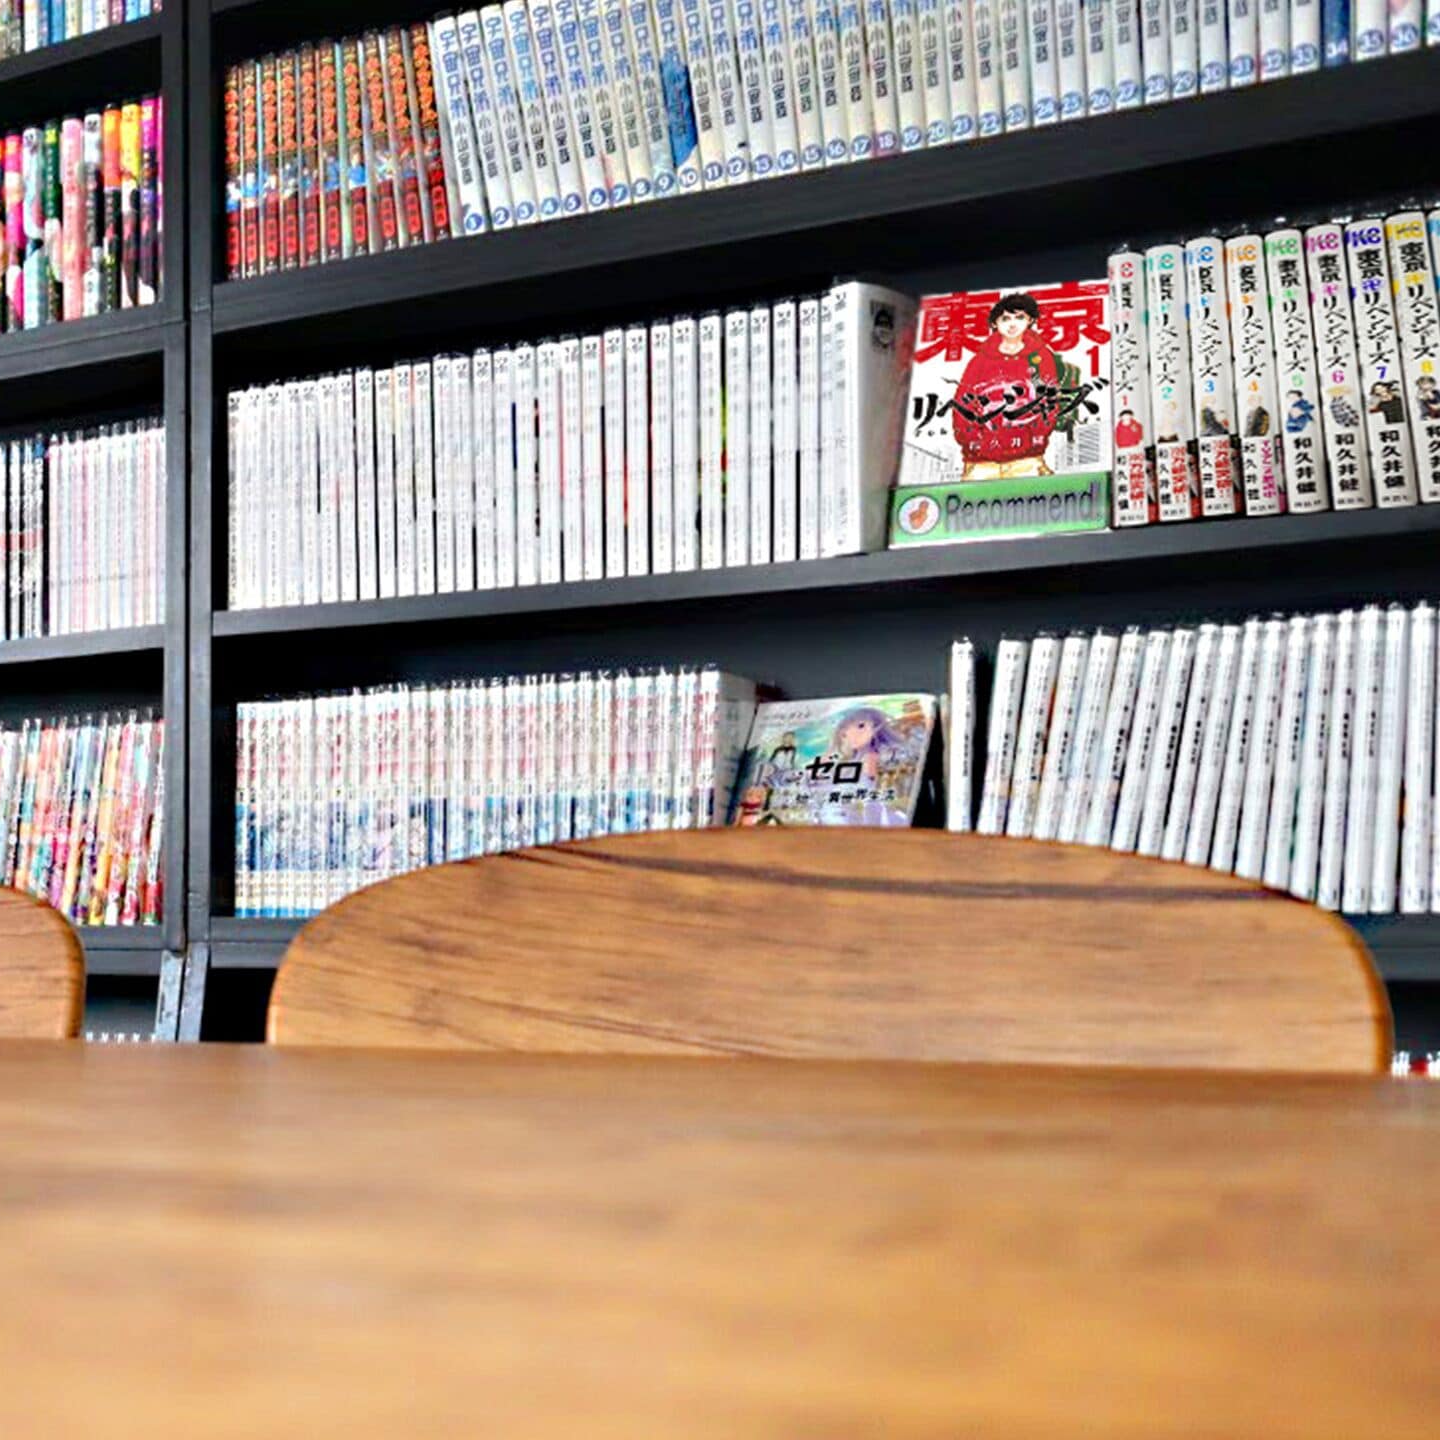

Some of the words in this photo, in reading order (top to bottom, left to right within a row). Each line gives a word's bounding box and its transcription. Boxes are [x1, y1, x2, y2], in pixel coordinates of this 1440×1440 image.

[510, 10, 538, 101] 宇宙兄弟
[533, 6, 561, 97] 宇宙兄弟
[1293, 48, 1316, 66] 33
[1326, 41, 1348, 59] 34
[462, 23, 490, 113] 宇宙兄弟
[485, 17, 514, 106] 宇宙兄弟
[1233, 57, 1253, 75] 31
[1263, 52, 1284, 69] 32
[1173, 74, 1194, 91] 29
[1090, 90, 1109, 108] 26
[952, 116, 970, 134] 21
[980, 114, 998, 132] 22
[878, 132, 895, 149] 18
[903, 128, 920, 144] 19
[927, 123, 945, 141] 20
[828, 141, 845, 156] 16
[852, 138, 869, 152] 17
[728, 158, 743, 174] 12
[755, 156, 771, 172] 13
[779, 152, 795, 167] 14
[681, 170, 696, 185] 10
[707, 164, 721, 179] 11
[913, 281, 1111, 363] 東京
[1085, 345, 1099, 377] 1
[1421, 360, 1434, 373] 8
[1292, 374, 1304, 388] 5
[1332, 370, 1345, 383] 6
[1376, 366, 1387, 380] 7
[1162, 387, 1173, 399] 2
[1204, 380, 1215, 393] 3
[1248, 380, 1258, 392] 4
[1122, 395, 1128, 406] 1
[1293, 437, 1317, 494] 和久井健
[1335, 433, 1359, 492] 和久井健
[1379, 430, 1405, 488] 和久井健
[946, 481, 1102, 532] Recommend!
